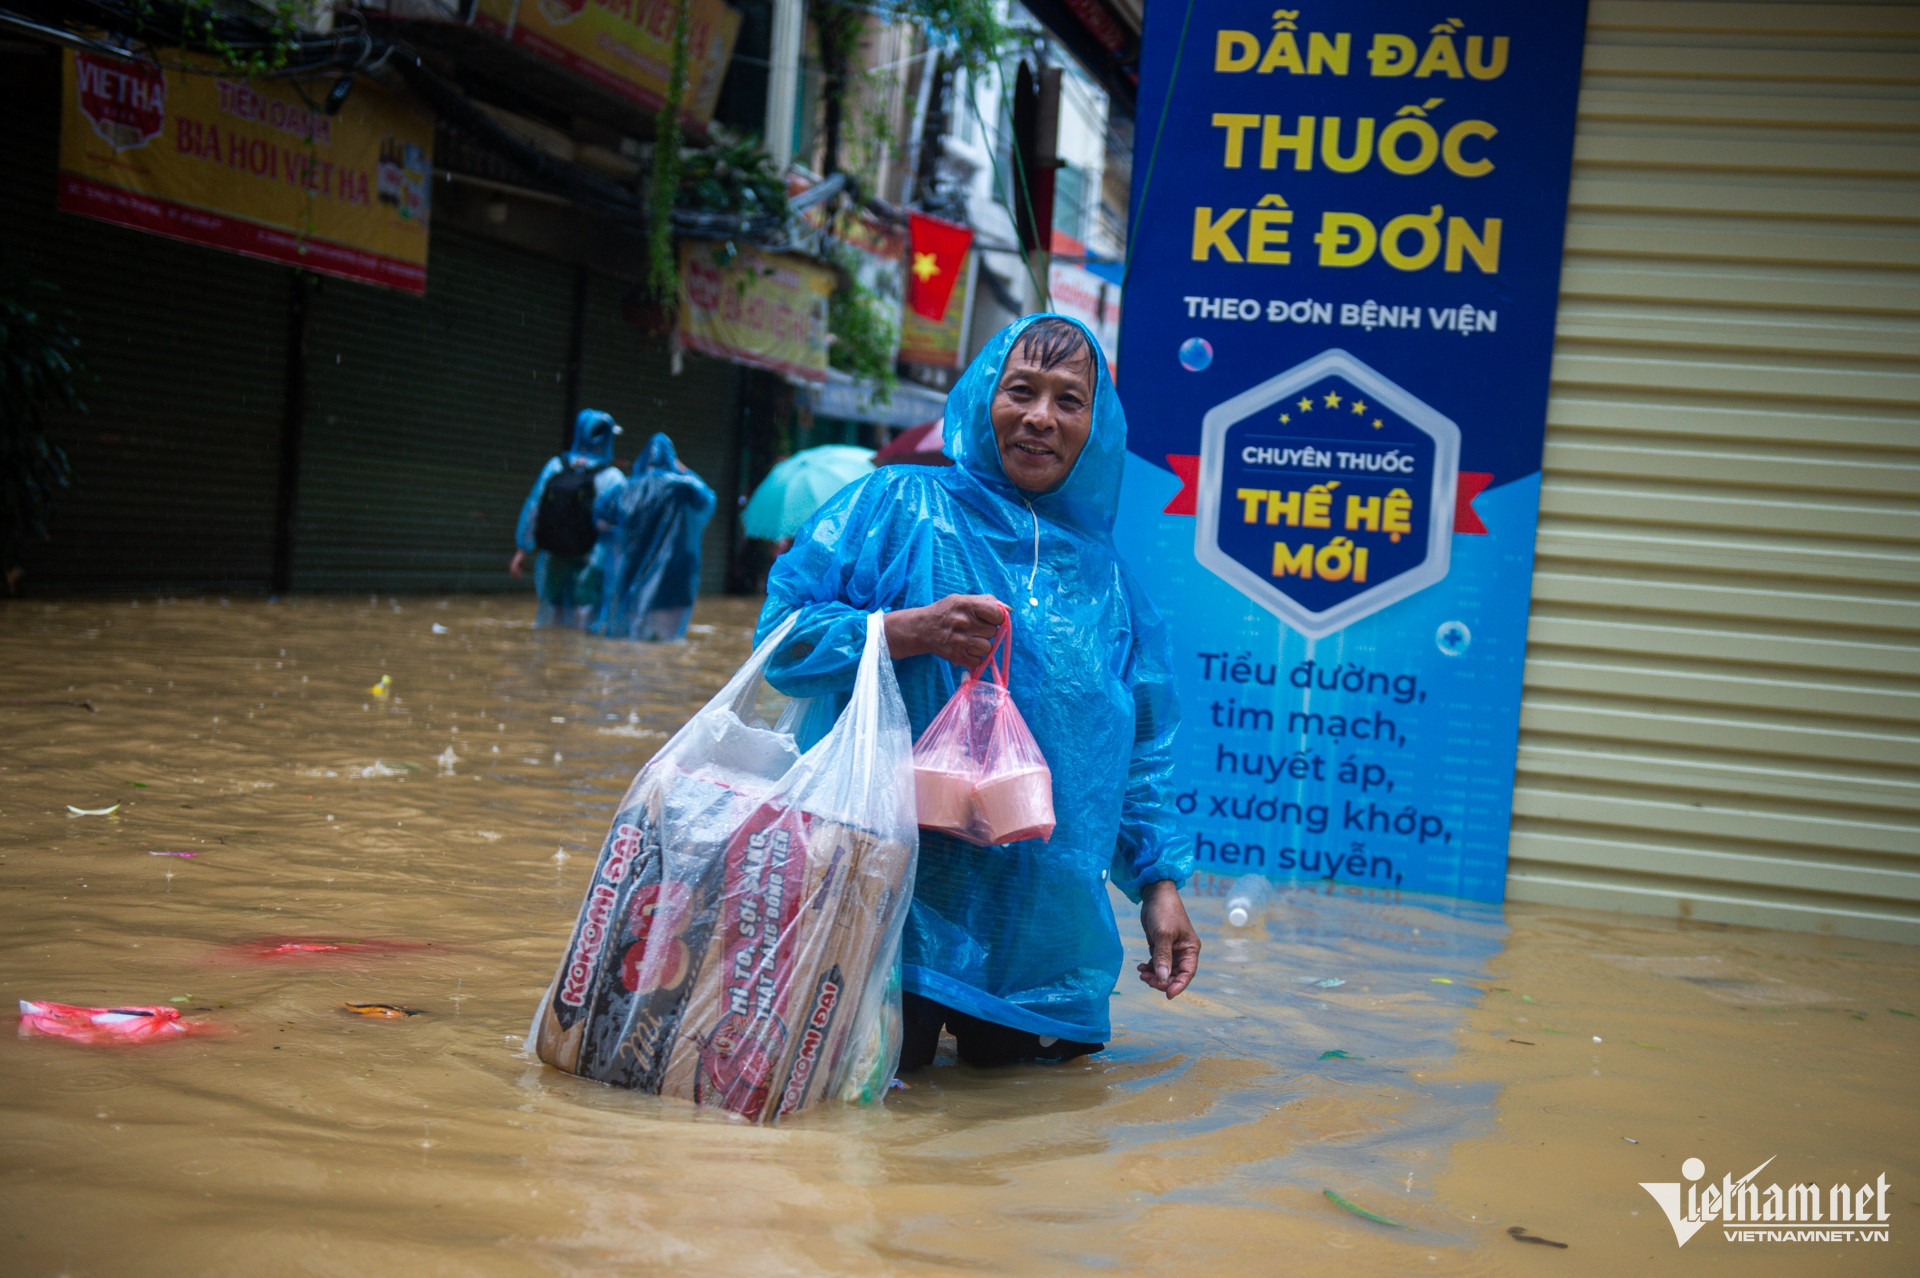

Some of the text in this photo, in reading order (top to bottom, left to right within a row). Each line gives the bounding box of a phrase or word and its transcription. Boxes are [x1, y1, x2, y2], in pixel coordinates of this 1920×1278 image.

[1214, 9, 1510, 80] DẪN ĐẦU
[176, 117, 222, 165] BIA
[1211, 97, 1499, 178] THUỐC
[1191, 193, 1503, 274] KÊ ĐƠN
[1183, 296, 1497, 336] THEO ĐƠN BỆNH VIỆN
[1241, 445, 1415, 474] CHUYÊN THUỐC
[1236, 480, 1414, 544] THẾ HỆ
[1271, 536, 1370, 584] MỚI
[1197, 651, 1427, 704] Tiểu đường,
[1210, 698, 1406, 748] tim mạch,
[1216, 744, 1395, 793] huyết áp,
[1176, 788, 1453, 845] ơ xương khớp,
[1195, 832, 1404, 885] hen suyễn,
[560, 823, 644, 1007] KOKOMI ĐẠI
[728, 986, 750, 1016] MÌ
[779, 981, 838, 1116] KOKOMI ĐẠI
